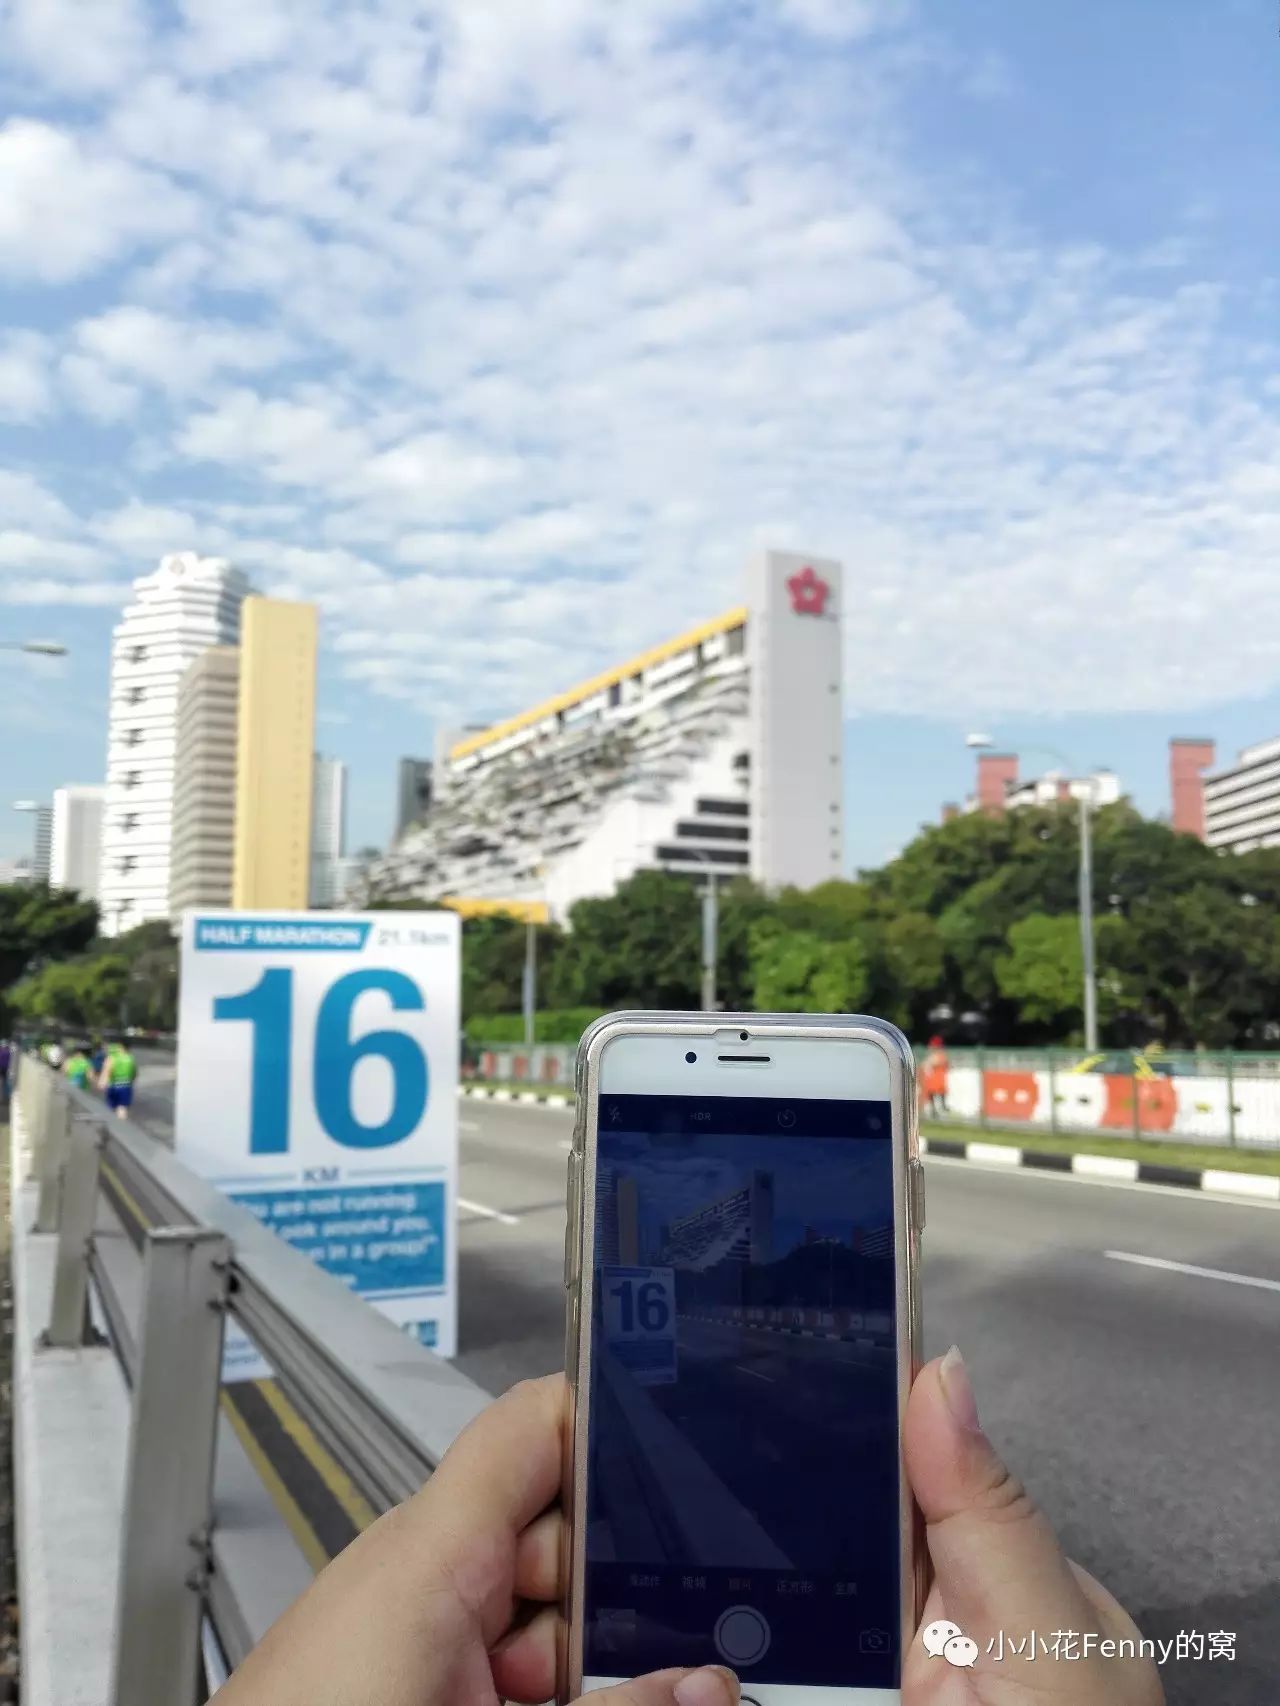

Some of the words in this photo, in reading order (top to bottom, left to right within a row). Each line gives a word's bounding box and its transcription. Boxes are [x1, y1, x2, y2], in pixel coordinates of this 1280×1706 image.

[201, 926, 251, 944] HALF
[255, 926, 361, 945] MARATHON
[213, 967, 429, 1154] 16
[303, 1168, 339, 1182] KM
[273, 1200, 304, 1216] are
[307, 1196, 341, 1213] not
[343, 1193, 416, 1212] running
[322, 1215, 388, 1237] around
[351, 1243, 365, 1260] a
[611, 1280, 668, 1331] 16
